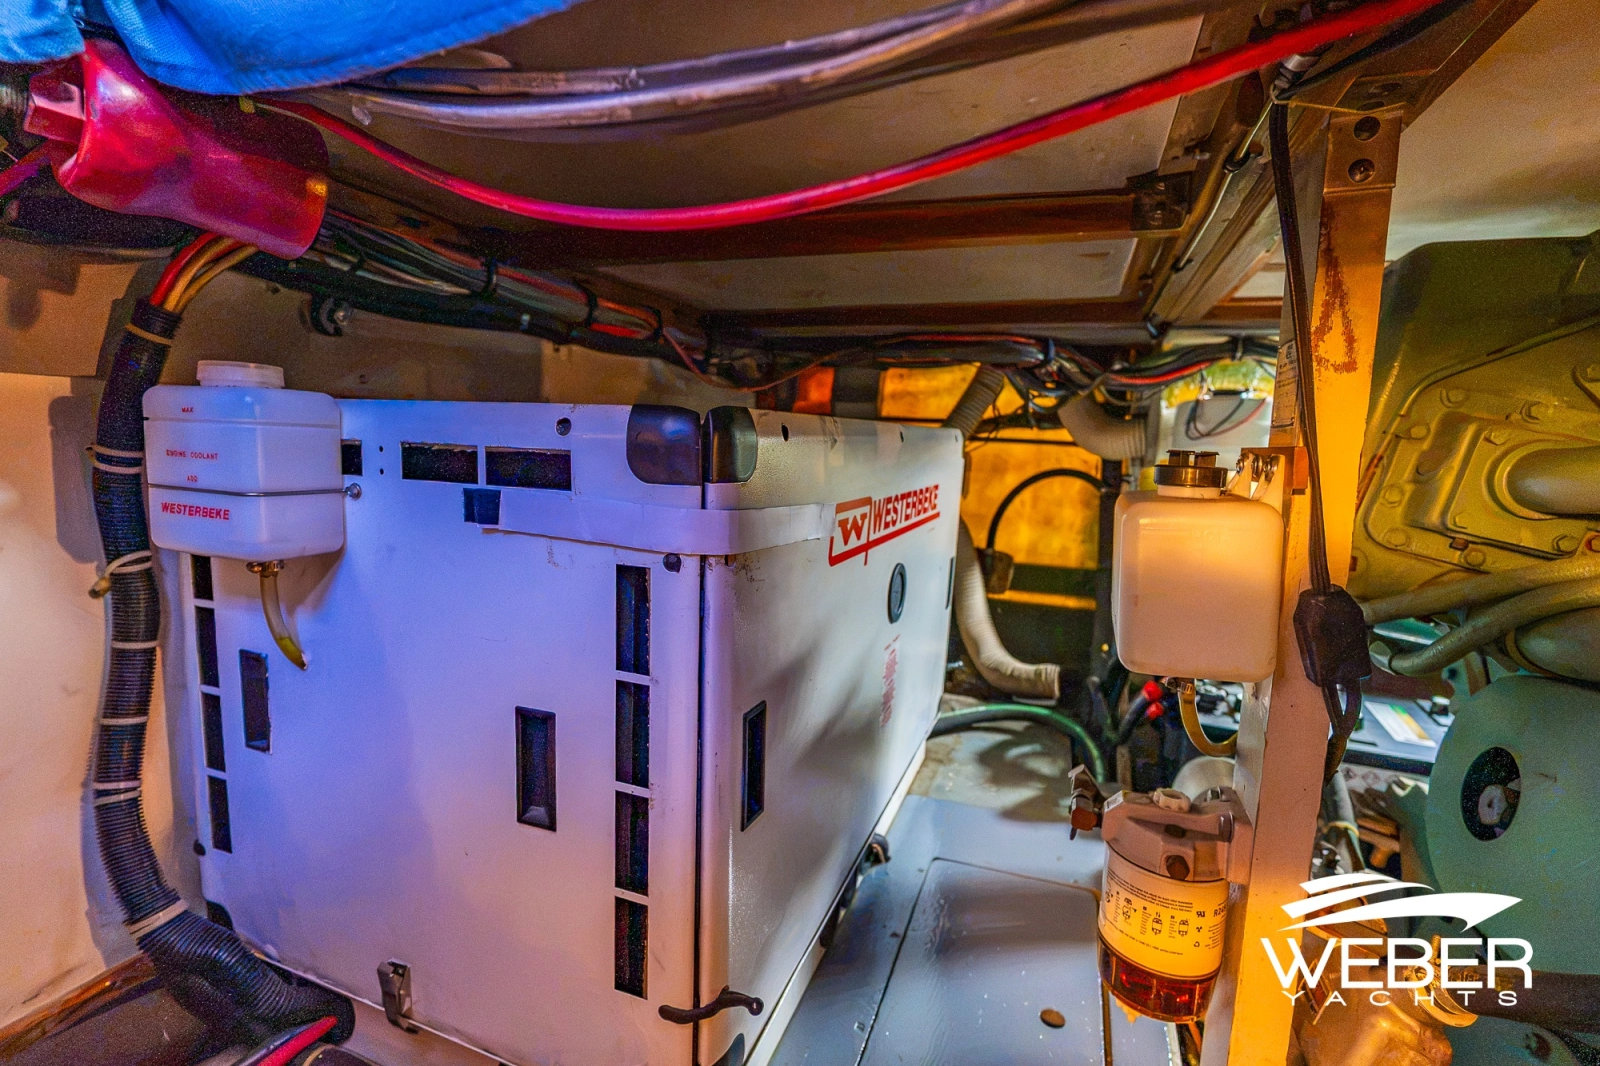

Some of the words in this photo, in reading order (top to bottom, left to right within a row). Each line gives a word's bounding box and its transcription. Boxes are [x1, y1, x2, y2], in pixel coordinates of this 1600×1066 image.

[166, 449, 186, 458] ENGINE
[190, 451, 218, 460] COOLANT
[161, 502, 230, 520] WESTERBEKE
[872, 484, 939, 533] WESTERBEKE
